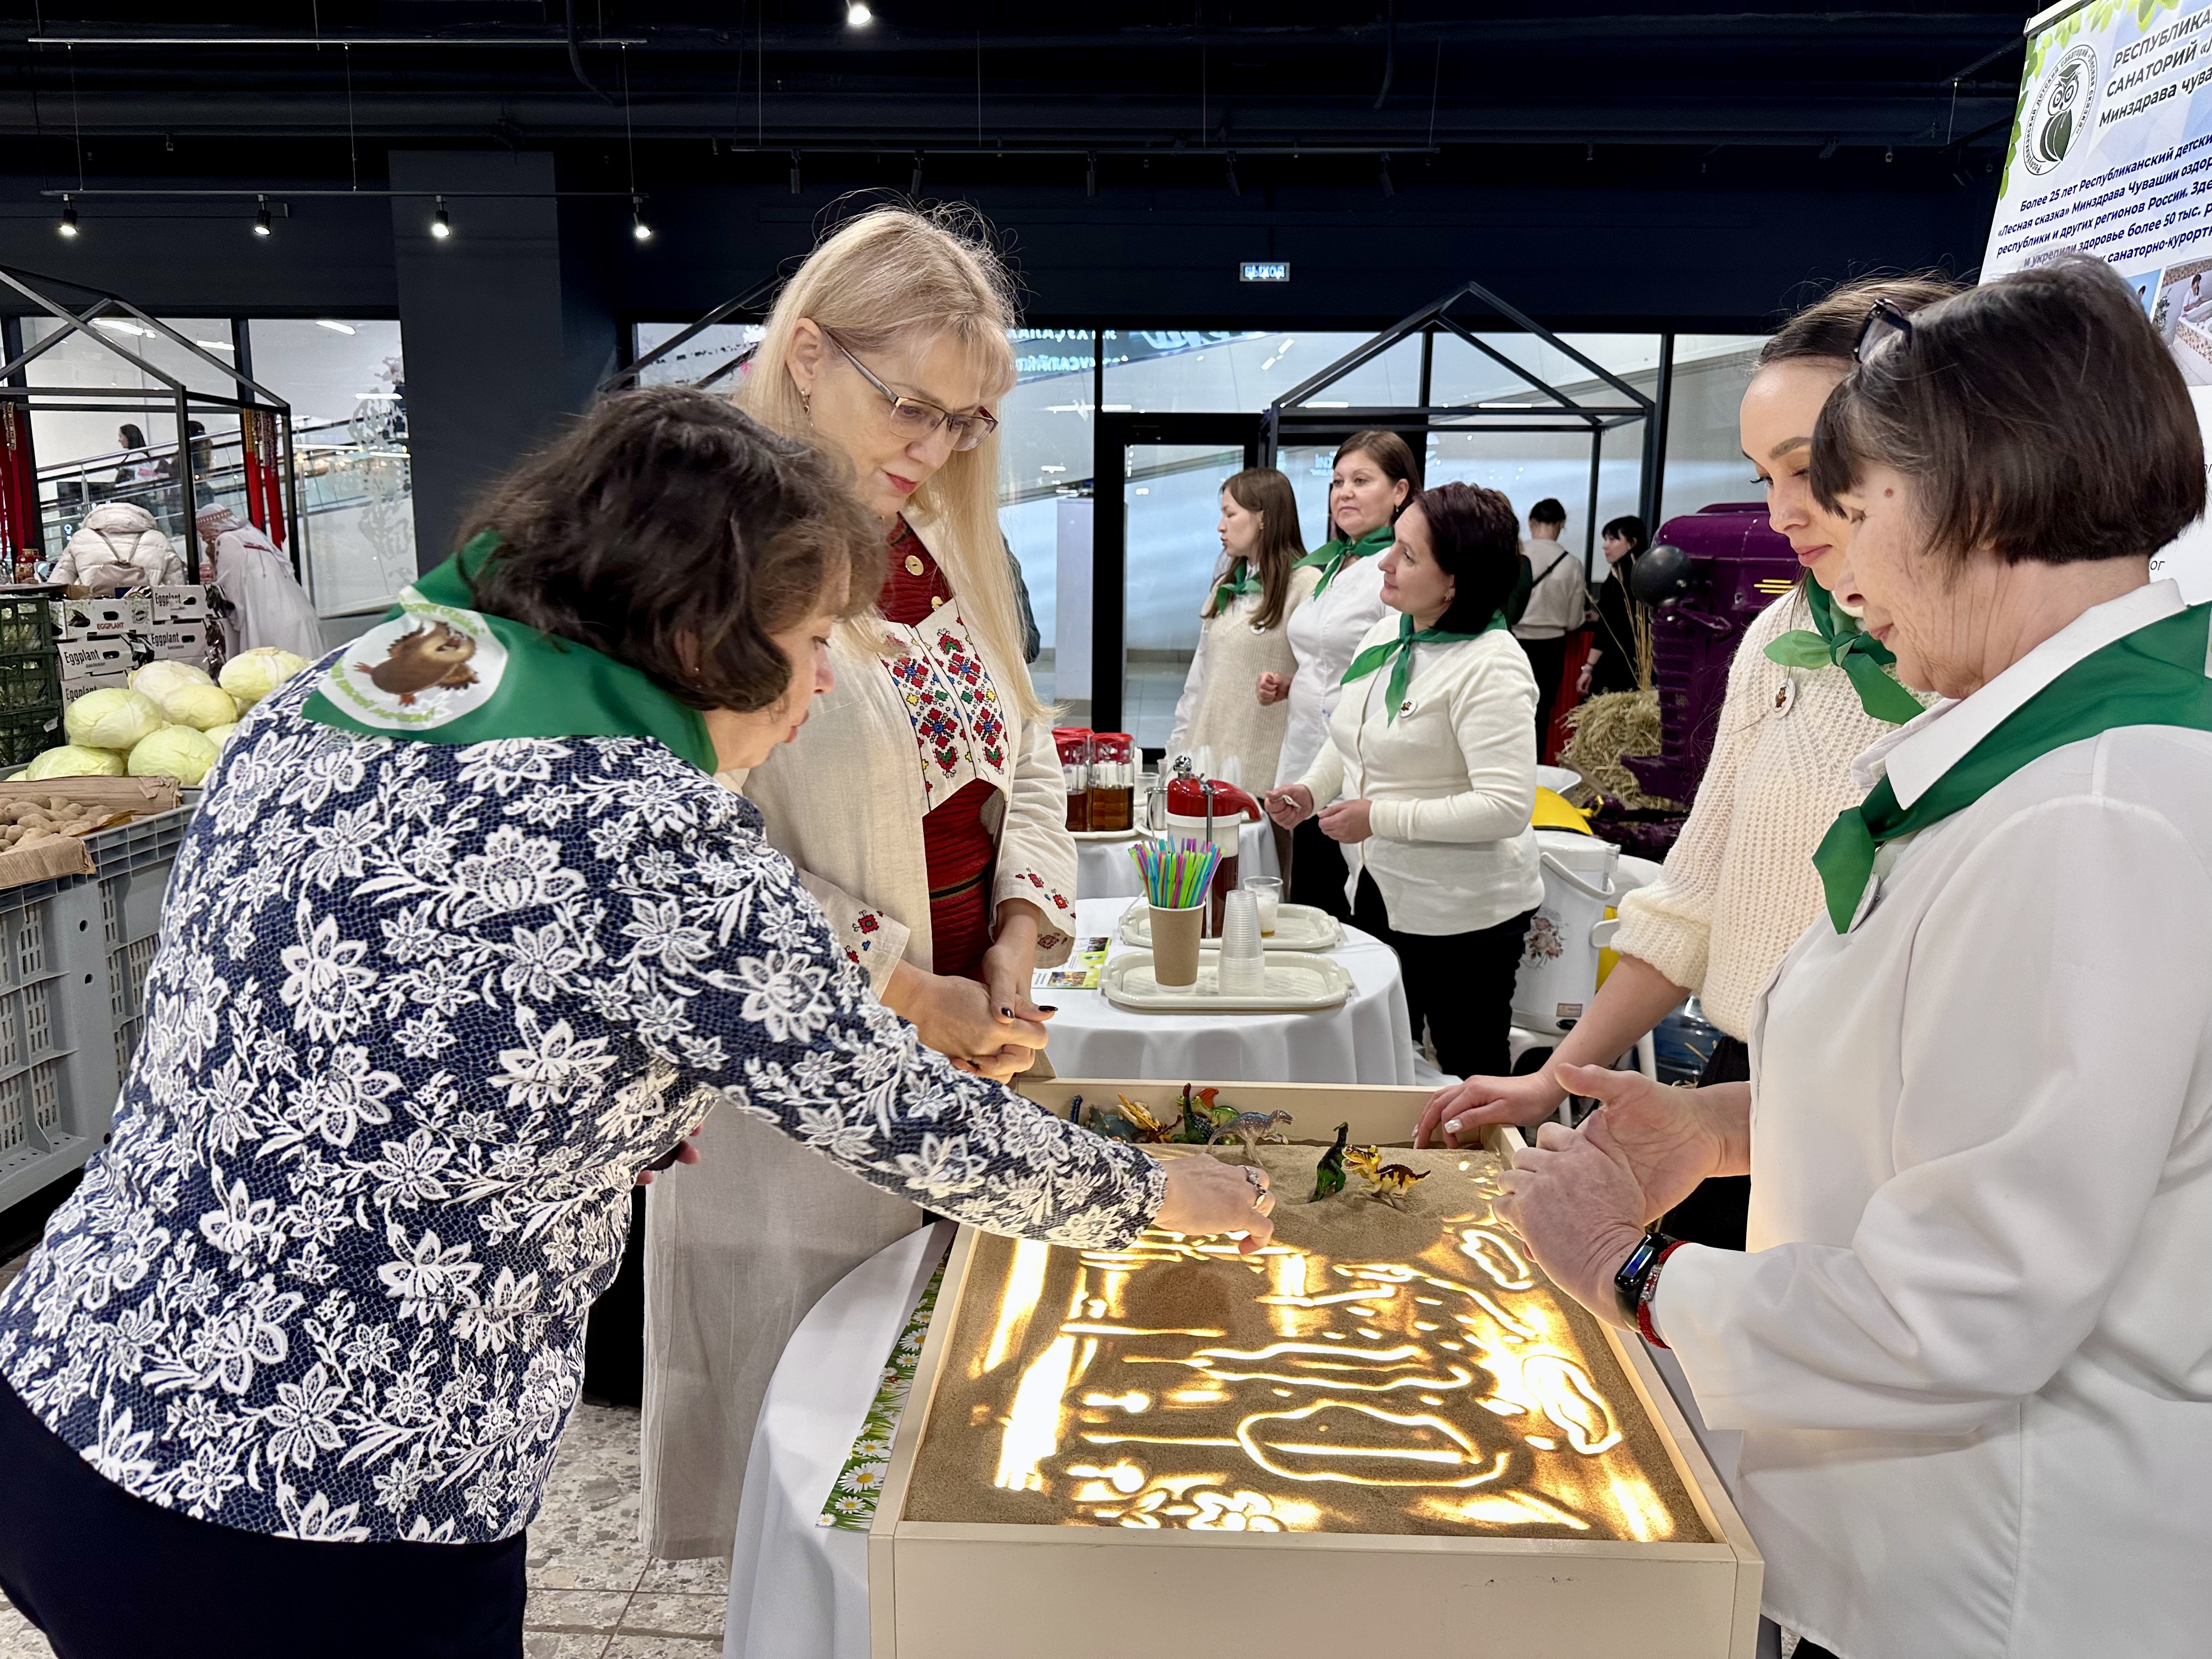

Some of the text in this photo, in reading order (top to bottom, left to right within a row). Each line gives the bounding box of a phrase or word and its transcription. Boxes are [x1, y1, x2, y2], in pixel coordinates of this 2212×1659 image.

[2113, 9, 2212, 69] РЕСПУБЛИКА
[2107, 39, 2198, 98] САНАТОРИЙ
[2098, 84, 2177, 127] Минздрава
[1997, 218, 2033, 236] «Лесная
[2034, 207, 2070, 226] сказка»
[2072, 187, 2125, 214] Минздрава
[2129, 168, 2180, 195] Чувашии
[2020, 195, 2047, 212] Более
[2049, 189, 2061, 202] 25
[2061, 184, 2078, 199] лет
[2079, 146, 2174, 192] Республиканский
[1996, 232, 2051, 259] республики
[2052, 229, 2059, 240] и
[2059, 218, 2094, 239] других
[2094, 202, 2146, 229] регионов
[2147, 188, 2188, 210] России.
[2078, 229, 2125, 252] здоровье
[2128, 219, 2162, 237] более
[2163, 211, 2176, 227] 50
[2177, 206, 2202, 223] тыс.
[155, 592, 181, 607] Eggplant
[64, 649, 99, 665] Eggplant
[151, 632, 179, 647] Eggplant
